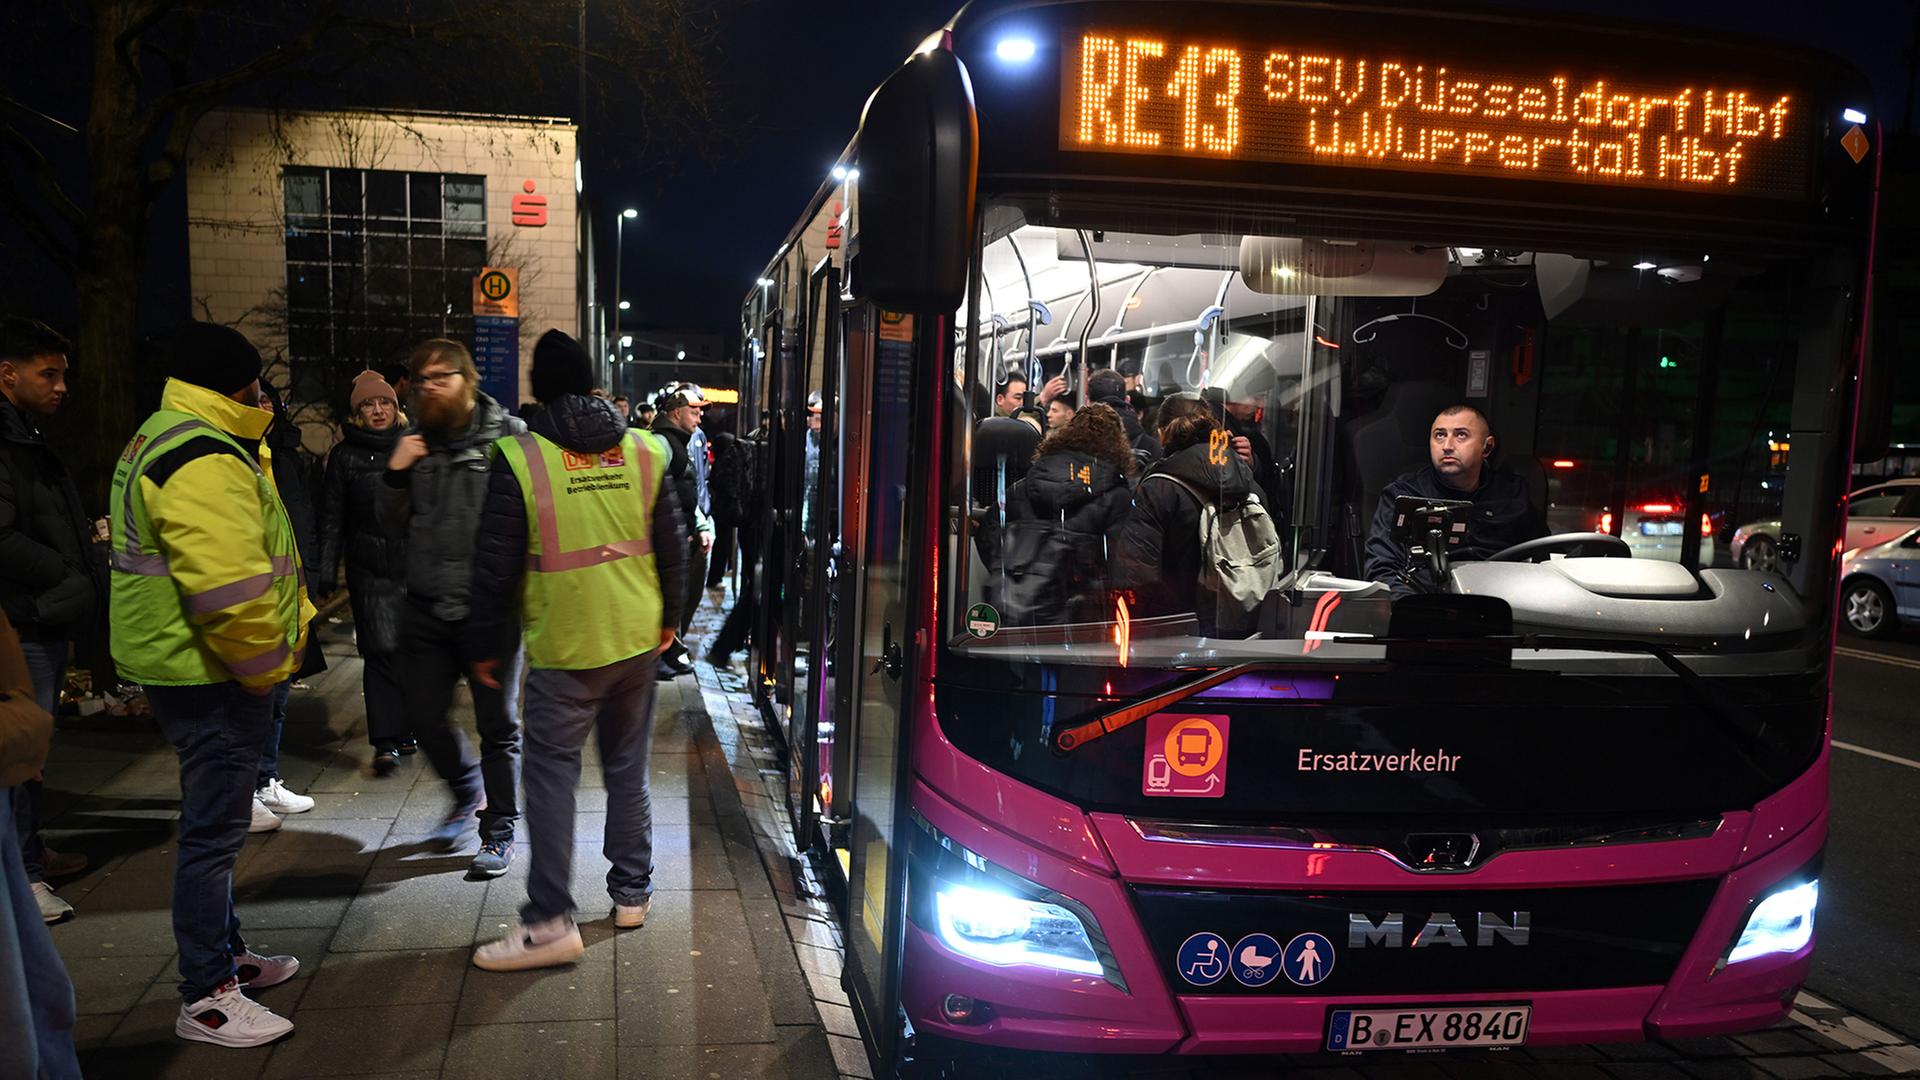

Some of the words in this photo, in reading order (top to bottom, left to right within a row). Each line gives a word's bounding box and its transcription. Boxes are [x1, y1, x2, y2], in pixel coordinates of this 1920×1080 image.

[1264, 53, 1364, 104] SEV
[1381, 62, 1693, 131] Düsseldorf
[1703, 90, 1791, 139] Hbf
[1659, 135, 1743, 184] Hbf
[489, 277, 503, 295] H
[569, 473, 624, 485] Ersatzverkehr
[1298, 748, 1462, 773] Ersatzverkehr
[1348, 911, 1532, 949] MAN
[1334, 1033, 1343, 1043] D
[1351, 1015, 1373, 1045] B
[1393, 1013, 1438, 1043] EX
[1443, 1011, 1523, 1042] 8840
